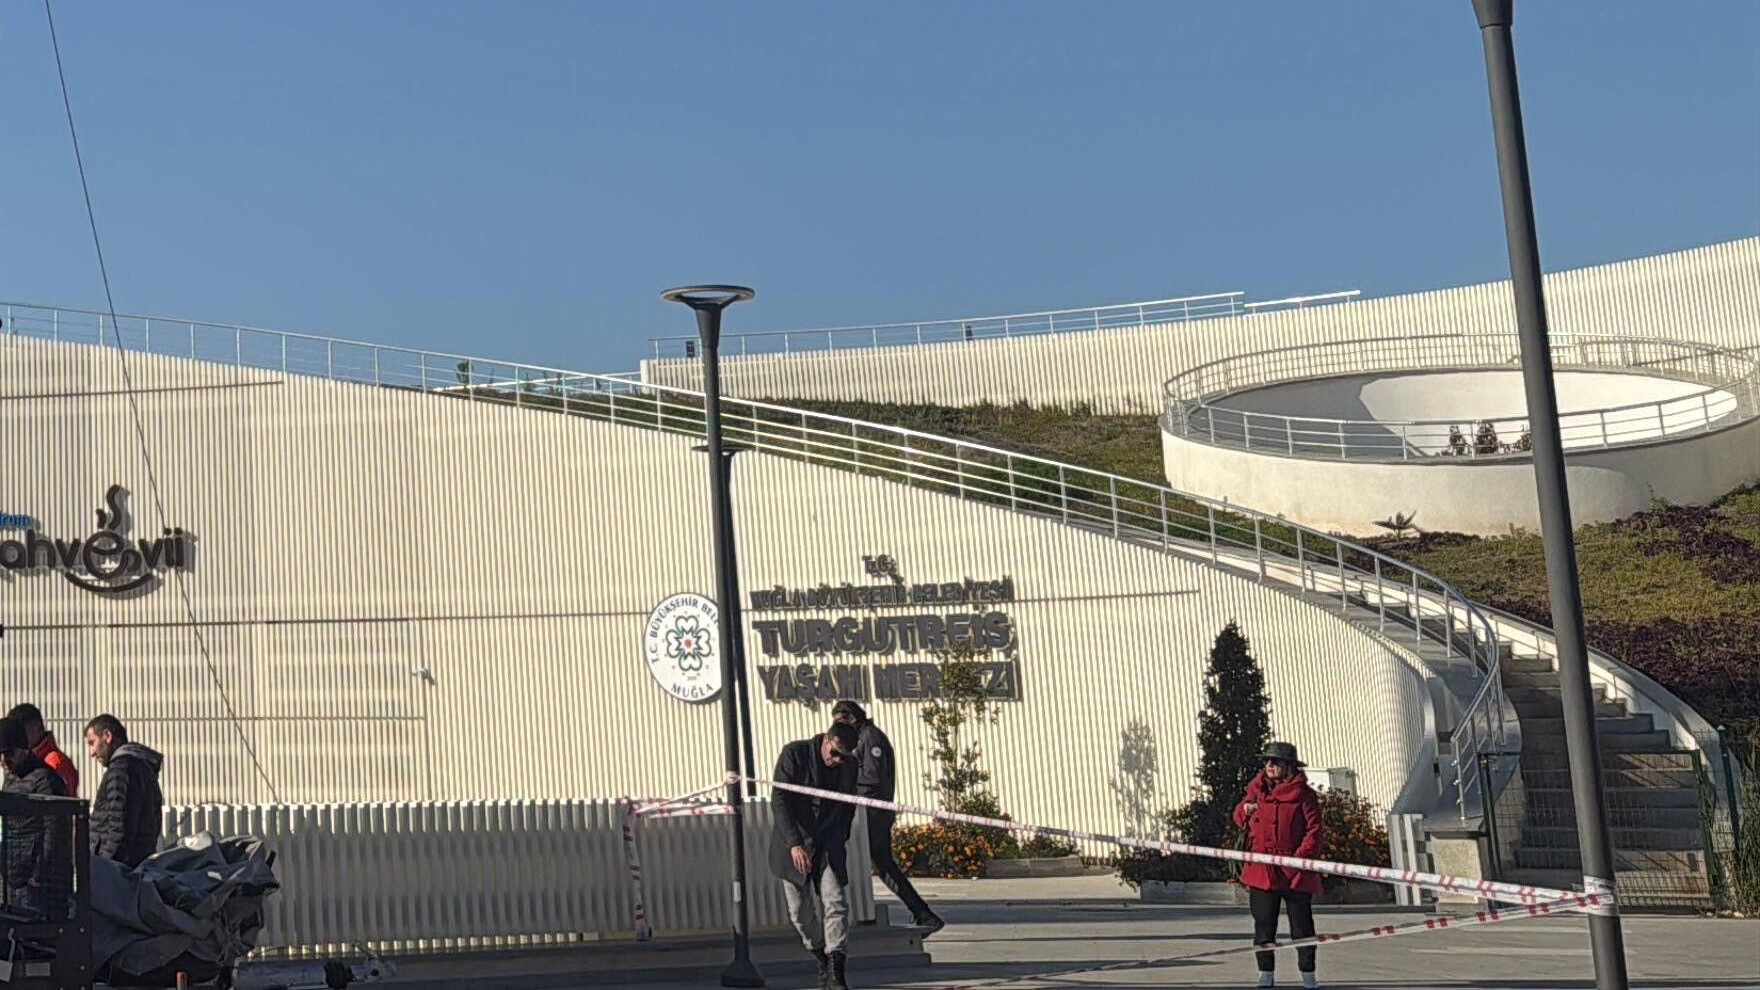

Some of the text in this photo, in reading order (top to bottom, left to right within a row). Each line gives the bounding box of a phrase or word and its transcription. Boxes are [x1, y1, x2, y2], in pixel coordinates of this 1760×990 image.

[650, 596, 699, 638] BÜYÜKŞEHİR
[752, 605, 1012, 655] TURGUTREİS
[671, 683, 714, 699] MUĞLA
[757, 663, 869, 707] YAŞAM
